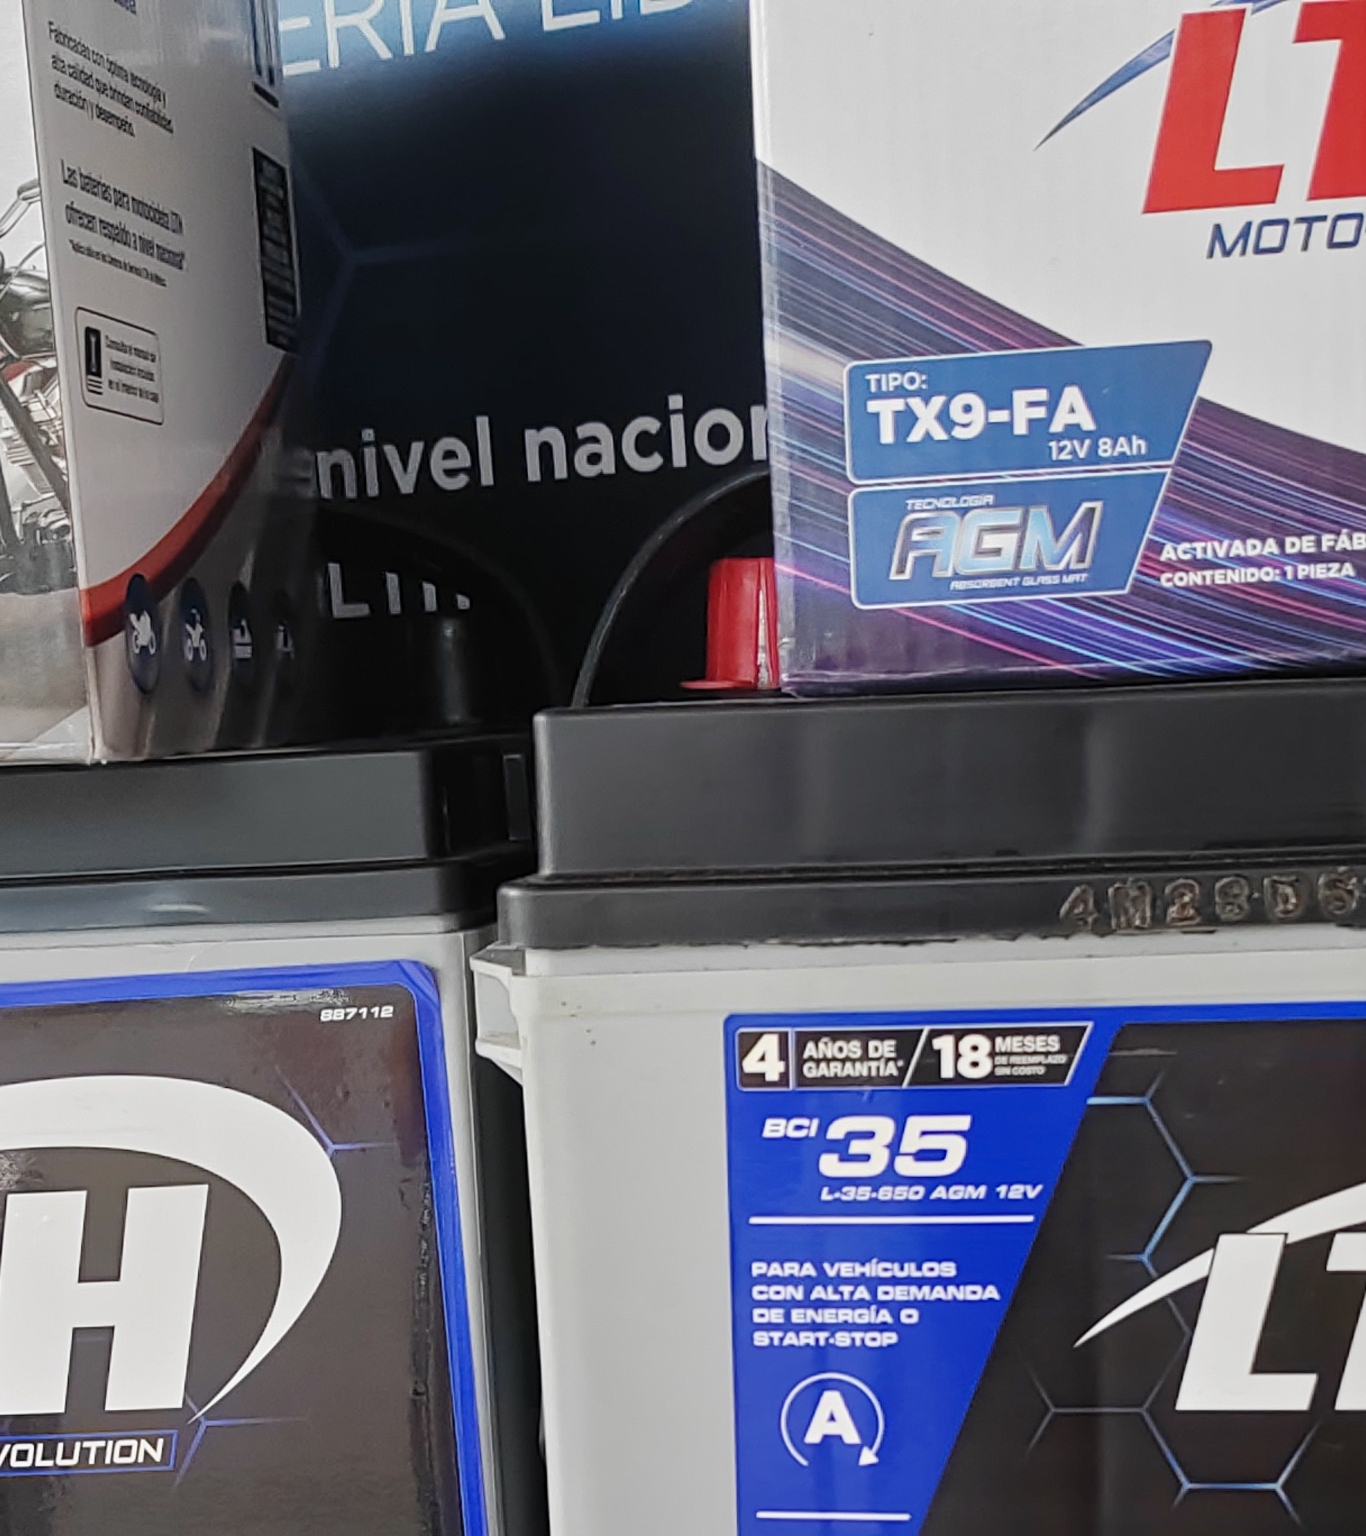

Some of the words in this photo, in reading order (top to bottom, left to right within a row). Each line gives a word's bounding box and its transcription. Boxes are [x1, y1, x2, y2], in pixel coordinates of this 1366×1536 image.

[865, 371, 928, 393] TIPO:
[866, 385, 1096, 444] TX9-FA
[316, 415, 494, 499] nivel
[1048, 439, 1091, 461] 12V
[1097, 435, 1147, 457] 8Ah
[889, 500, 1103, 580] AGM
[1160, 538, 1279, 561] ACTIVADA
[1285, 536, 1316, 554] DE
[1160, 569, 1280, 588] CONTENIDO:
[1284, 566, 1292, 580] 1
[1297, 562, 1356, 580] PIEZA
[320, 1006, 393, 1022] 887112
[742, 1033, 784, 1081] 4
[803, 1039, 861, 1059] AÑOS
[868, 1040, 896, 1056] DE
[933, 1034, 993, 1079] 18
[995, 1036, 1060, 1052] MESES
[762, 1118, 819, 1138] BCI
[819, 1115, 971, 1178] 35
[930, 1185, 986, 1199] AGM
[995, 1185, 1043, 1198] 12V
[752, 1262, 817, 1278] PARA
[823, 1258, 957, 1278] VEHÍCULOS
[752, 1286, 803, 1301] CON
[810, 1286, 870, 1300] ALTA
[877, 1285, 1000, 1300] DEMANDA
[752, 1309, 783, 1323] DE
[791, 1305, 893, 1324] ENERGÍA
[900, 1309, 919, 1323] O
[753, 1332, 898, 1347] START-STOP
[804, 1390, 861, 1444] A
